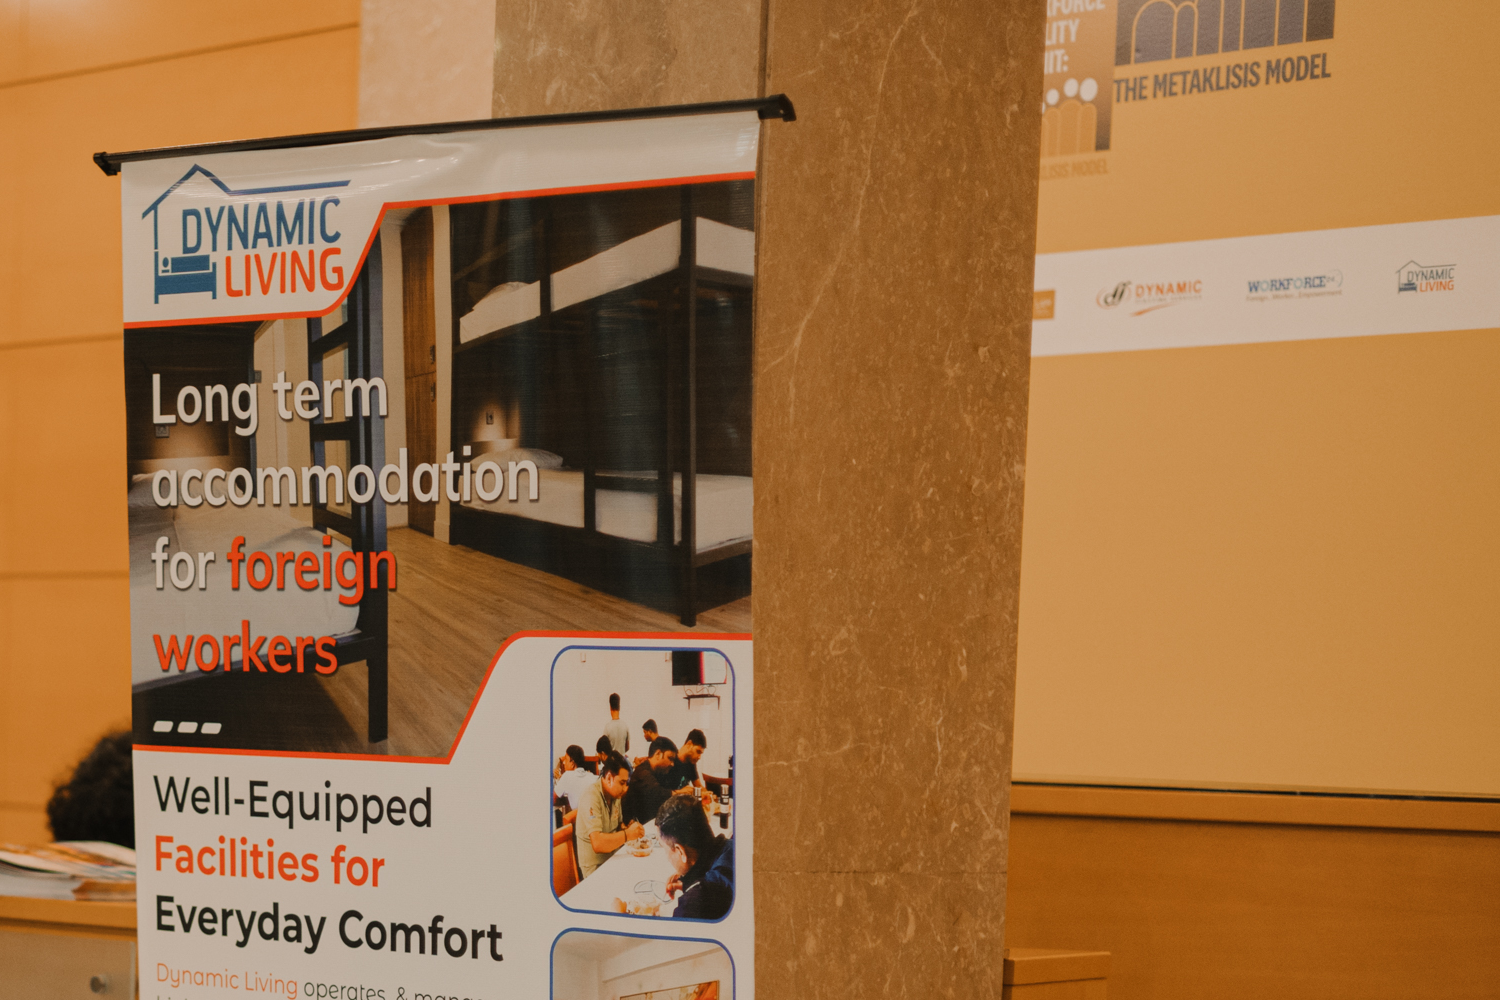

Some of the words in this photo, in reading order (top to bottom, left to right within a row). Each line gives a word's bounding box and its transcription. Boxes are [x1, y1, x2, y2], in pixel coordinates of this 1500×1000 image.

[1114, 76, 1148, 102] THE
[1153, 62, 1260, 98] METAKLISIS
[1265, 52, 1331, 85] MODEL
[181, 196, 341, 255] DYNAMIC
[224, 247, 345, 298] LIVING
[1135, 280, 1202, 297] DYNAMIC
[1407, 268, 1454, 282] DYNAMIC
[1420, 280, 1454, 292] LIVING
[151, 373, 259, 437] Long
[272, 370, 388, 419] term
[151, 445, 539, 507] accommodation
[151, 537, 215, 591] for
[227, 537, 397, 605] foreign
[153, 620, 338, 674] workers
[153, 774, 432, 834] Well-Equipped
[155, 834, 319, 883] Facilities
[331, 844, 385, 888] for
[156, 894, 327, 954] Everyday
[339, 909, 504, 962] Comfort
[156, 962, 239, 989] Dynamic
[244, 970, 298, 1000] Living
